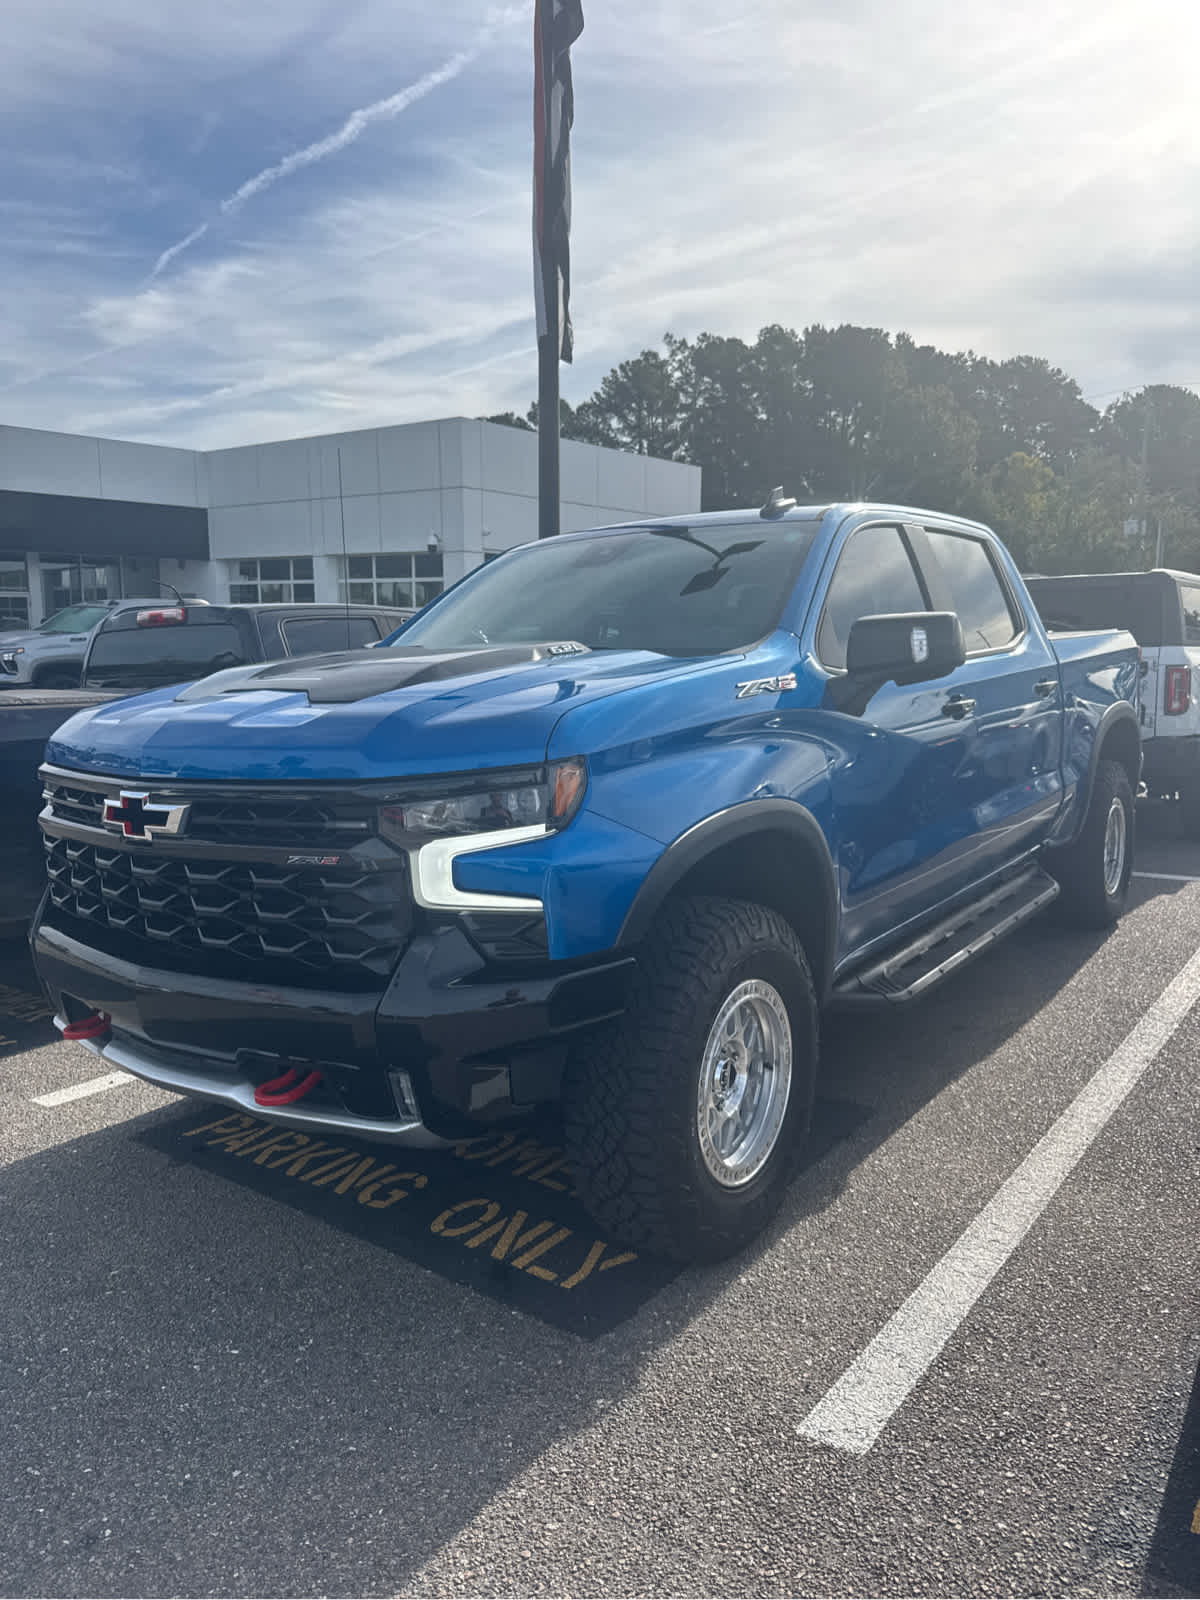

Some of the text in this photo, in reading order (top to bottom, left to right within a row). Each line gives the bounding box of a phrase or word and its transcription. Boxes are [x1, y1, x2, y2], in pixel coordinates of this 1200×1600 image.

[735, 672, 799, 700] ZR2
[183, 1112, 640, 1289] PARKING ONLY
